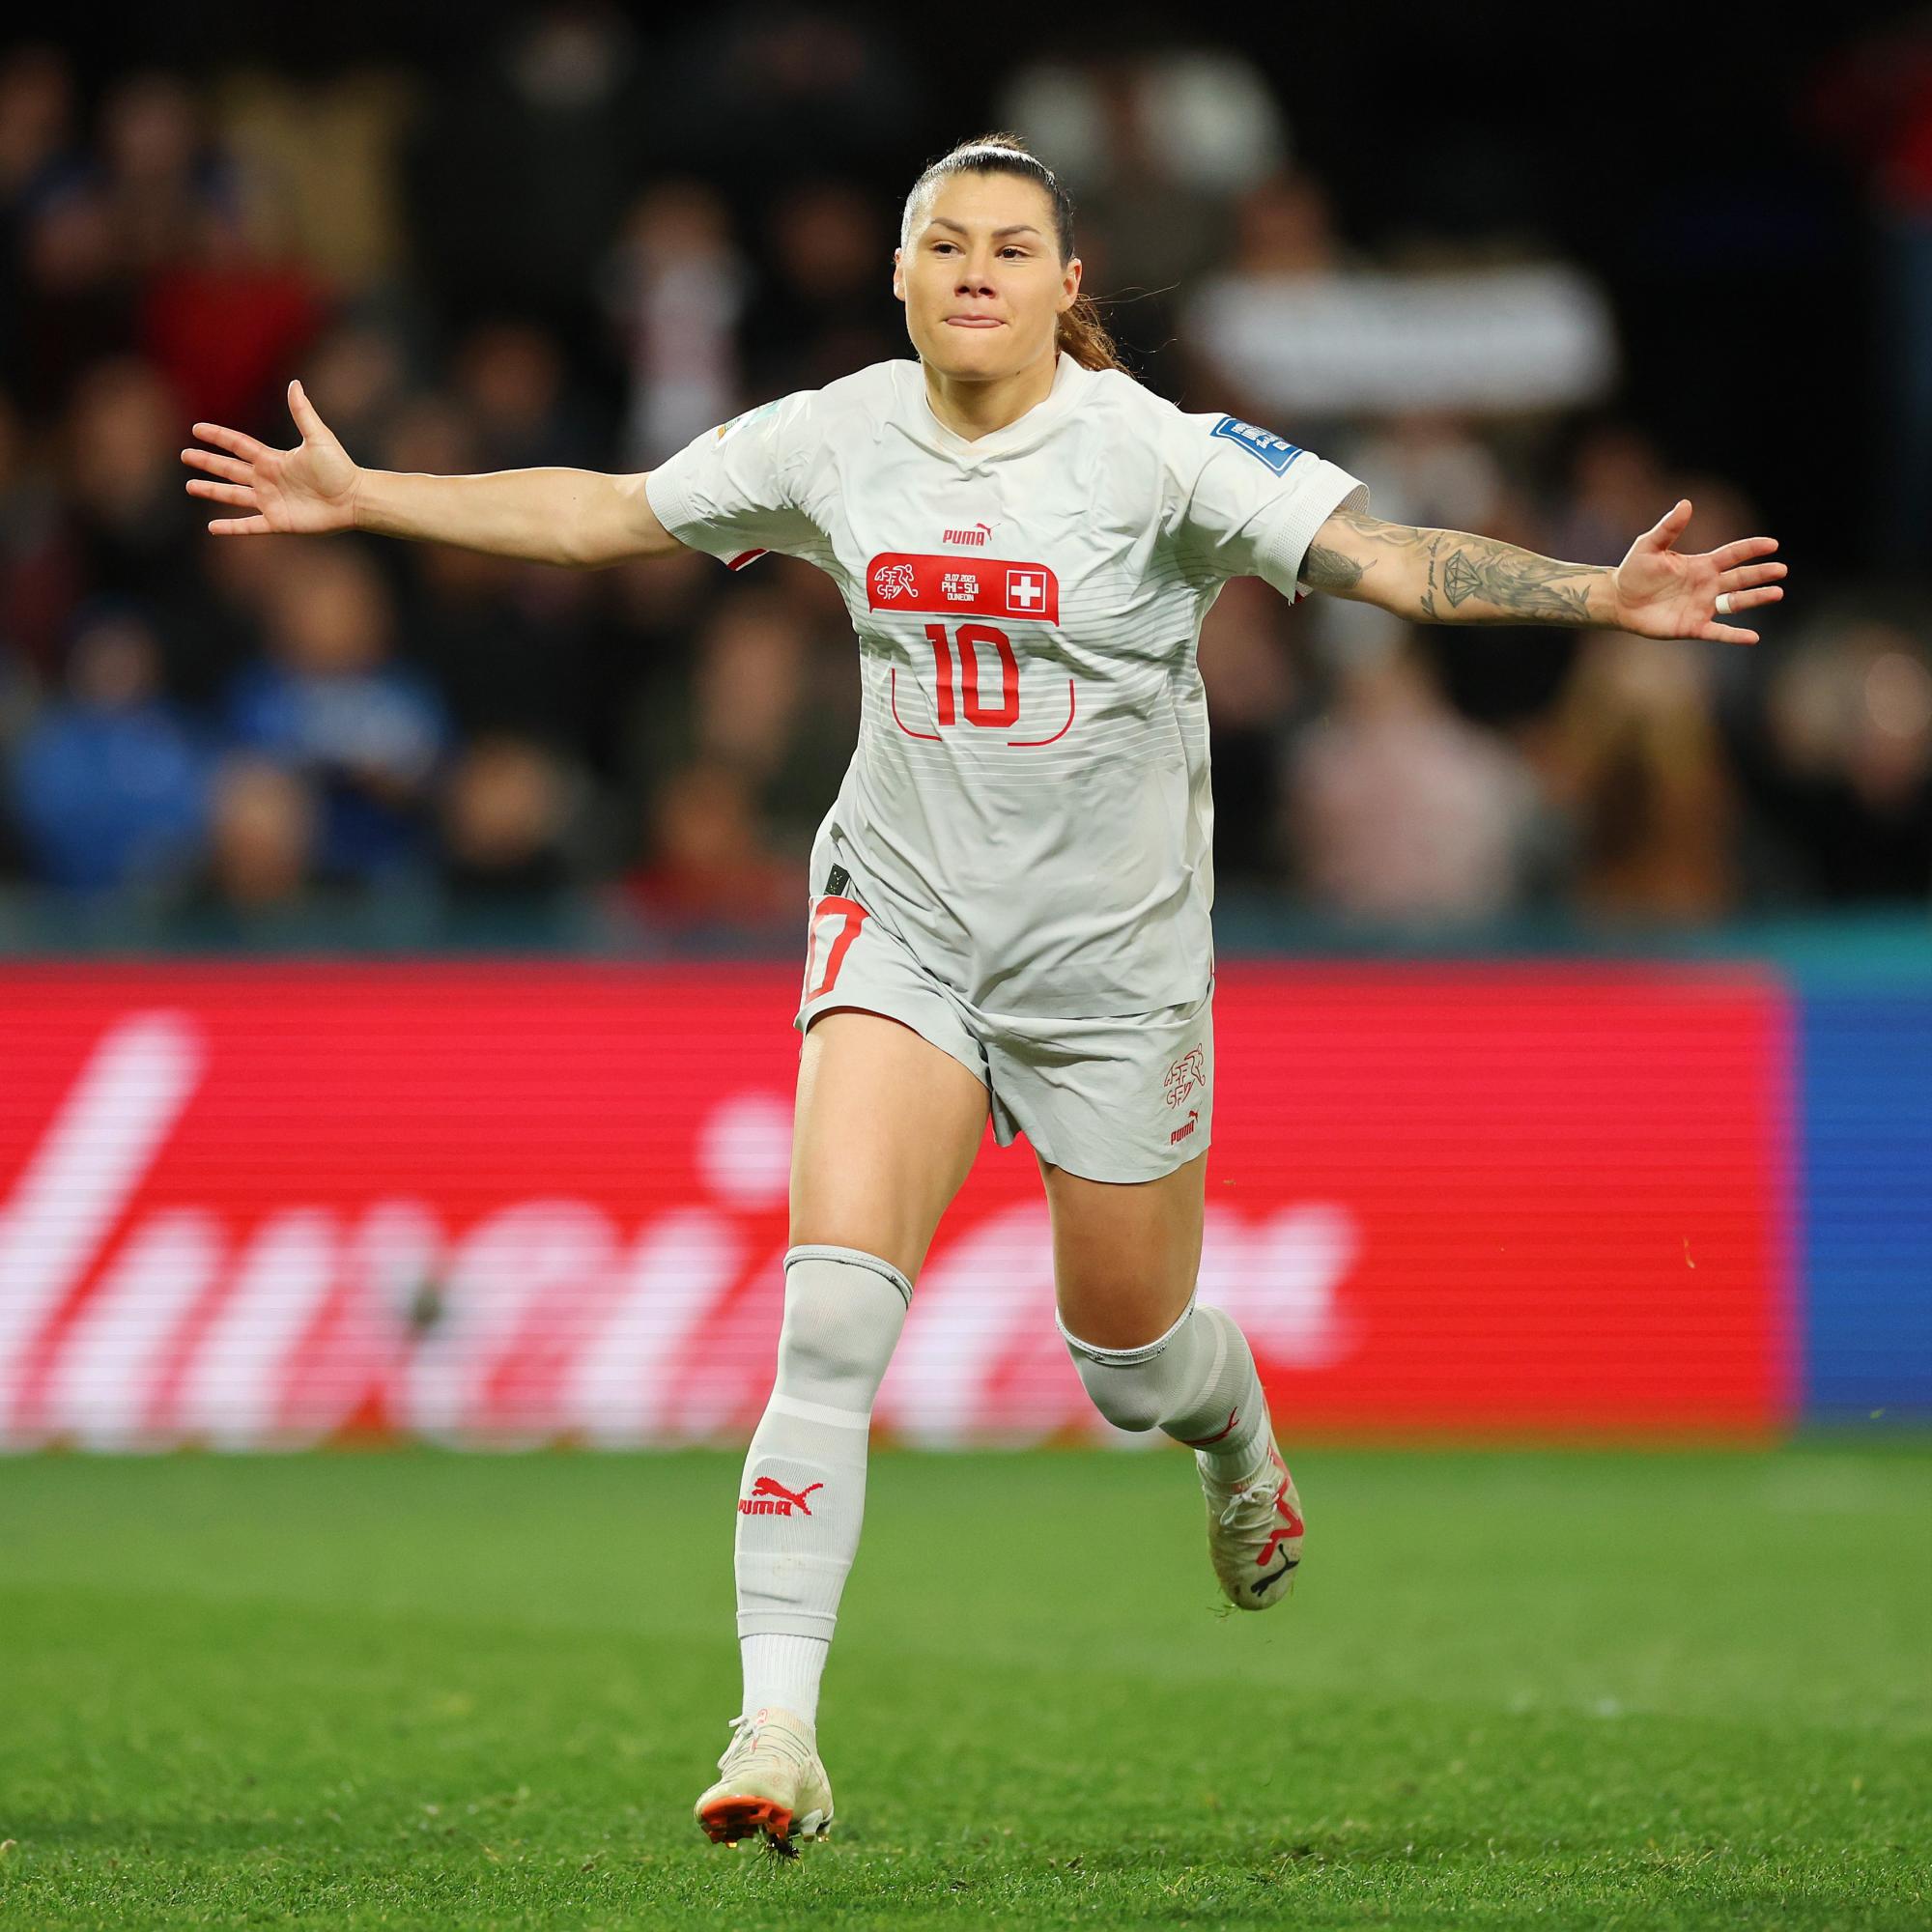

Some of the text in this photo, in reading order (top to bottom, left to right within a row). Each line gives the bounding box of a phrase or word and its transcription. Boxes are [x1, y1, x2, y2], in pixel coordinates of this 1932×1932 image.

[943, 529, 984, 546] PUMA
[941, 582, 956, 592] PHI
[964, 583, 979, 594] SUI
[924, 623, 1019, 727] 10
[1171, 1120, 1195, 1145] PUMA
